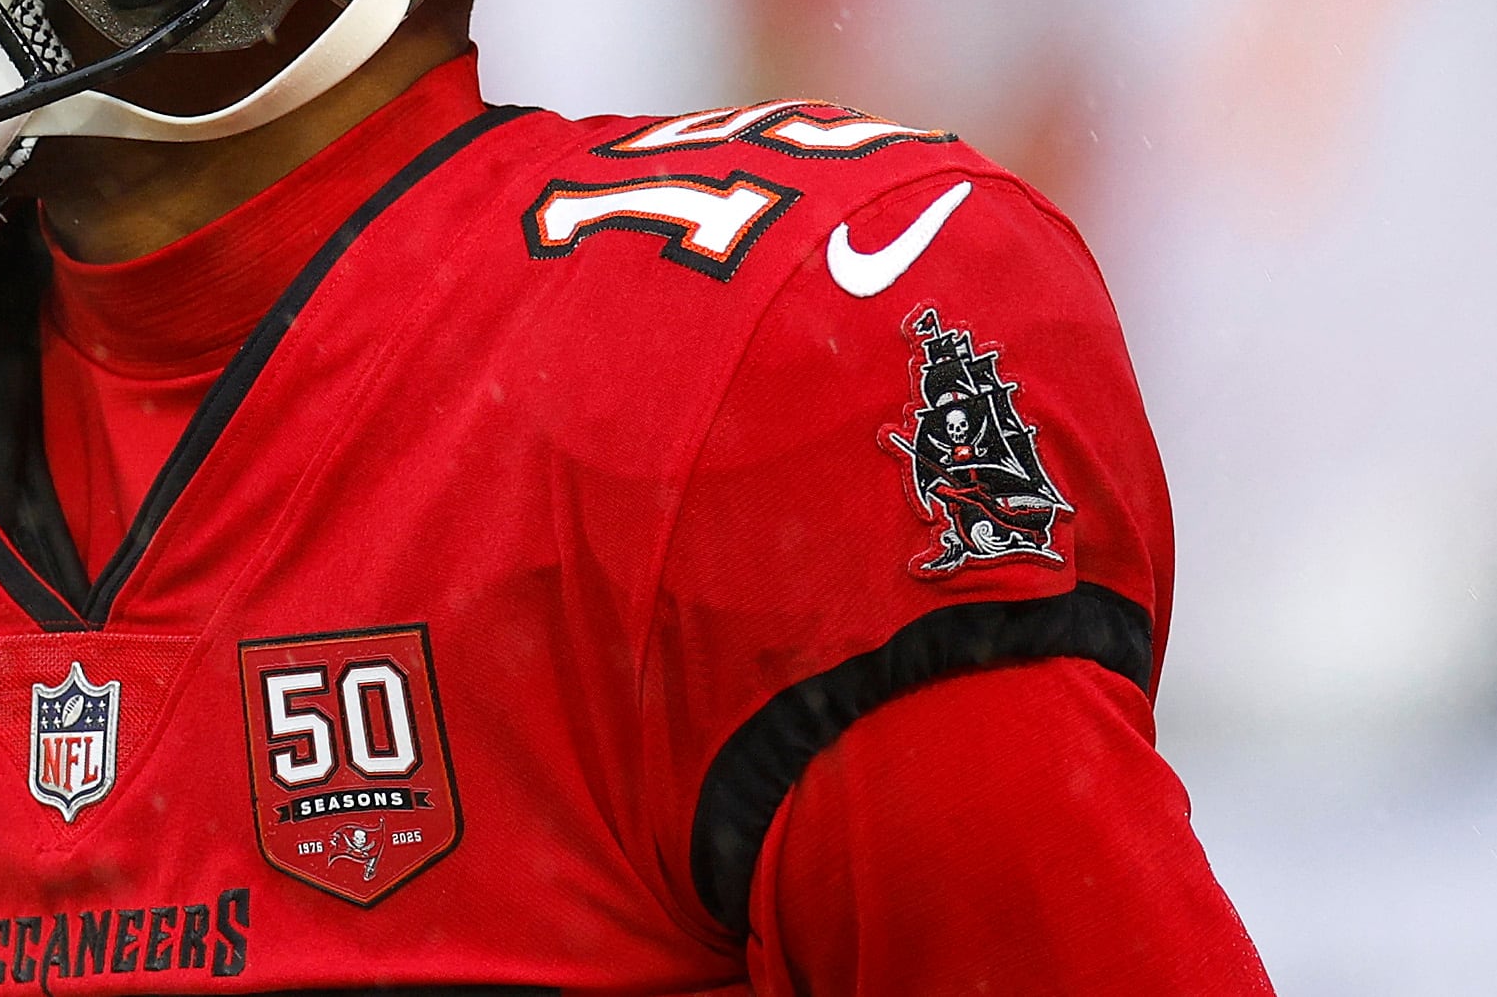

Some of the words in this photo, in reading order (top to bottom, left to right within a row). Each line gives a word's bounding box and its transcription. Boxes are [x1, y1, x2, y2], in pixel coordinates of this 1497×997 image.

[259, 658, 423, 789] 50
[41, 736, 99, 792] NFL
[300, 792, 404, 816] SEASONS
[298, 841, 323, 855] 1976
[392, 831, 422, 845] 2025
